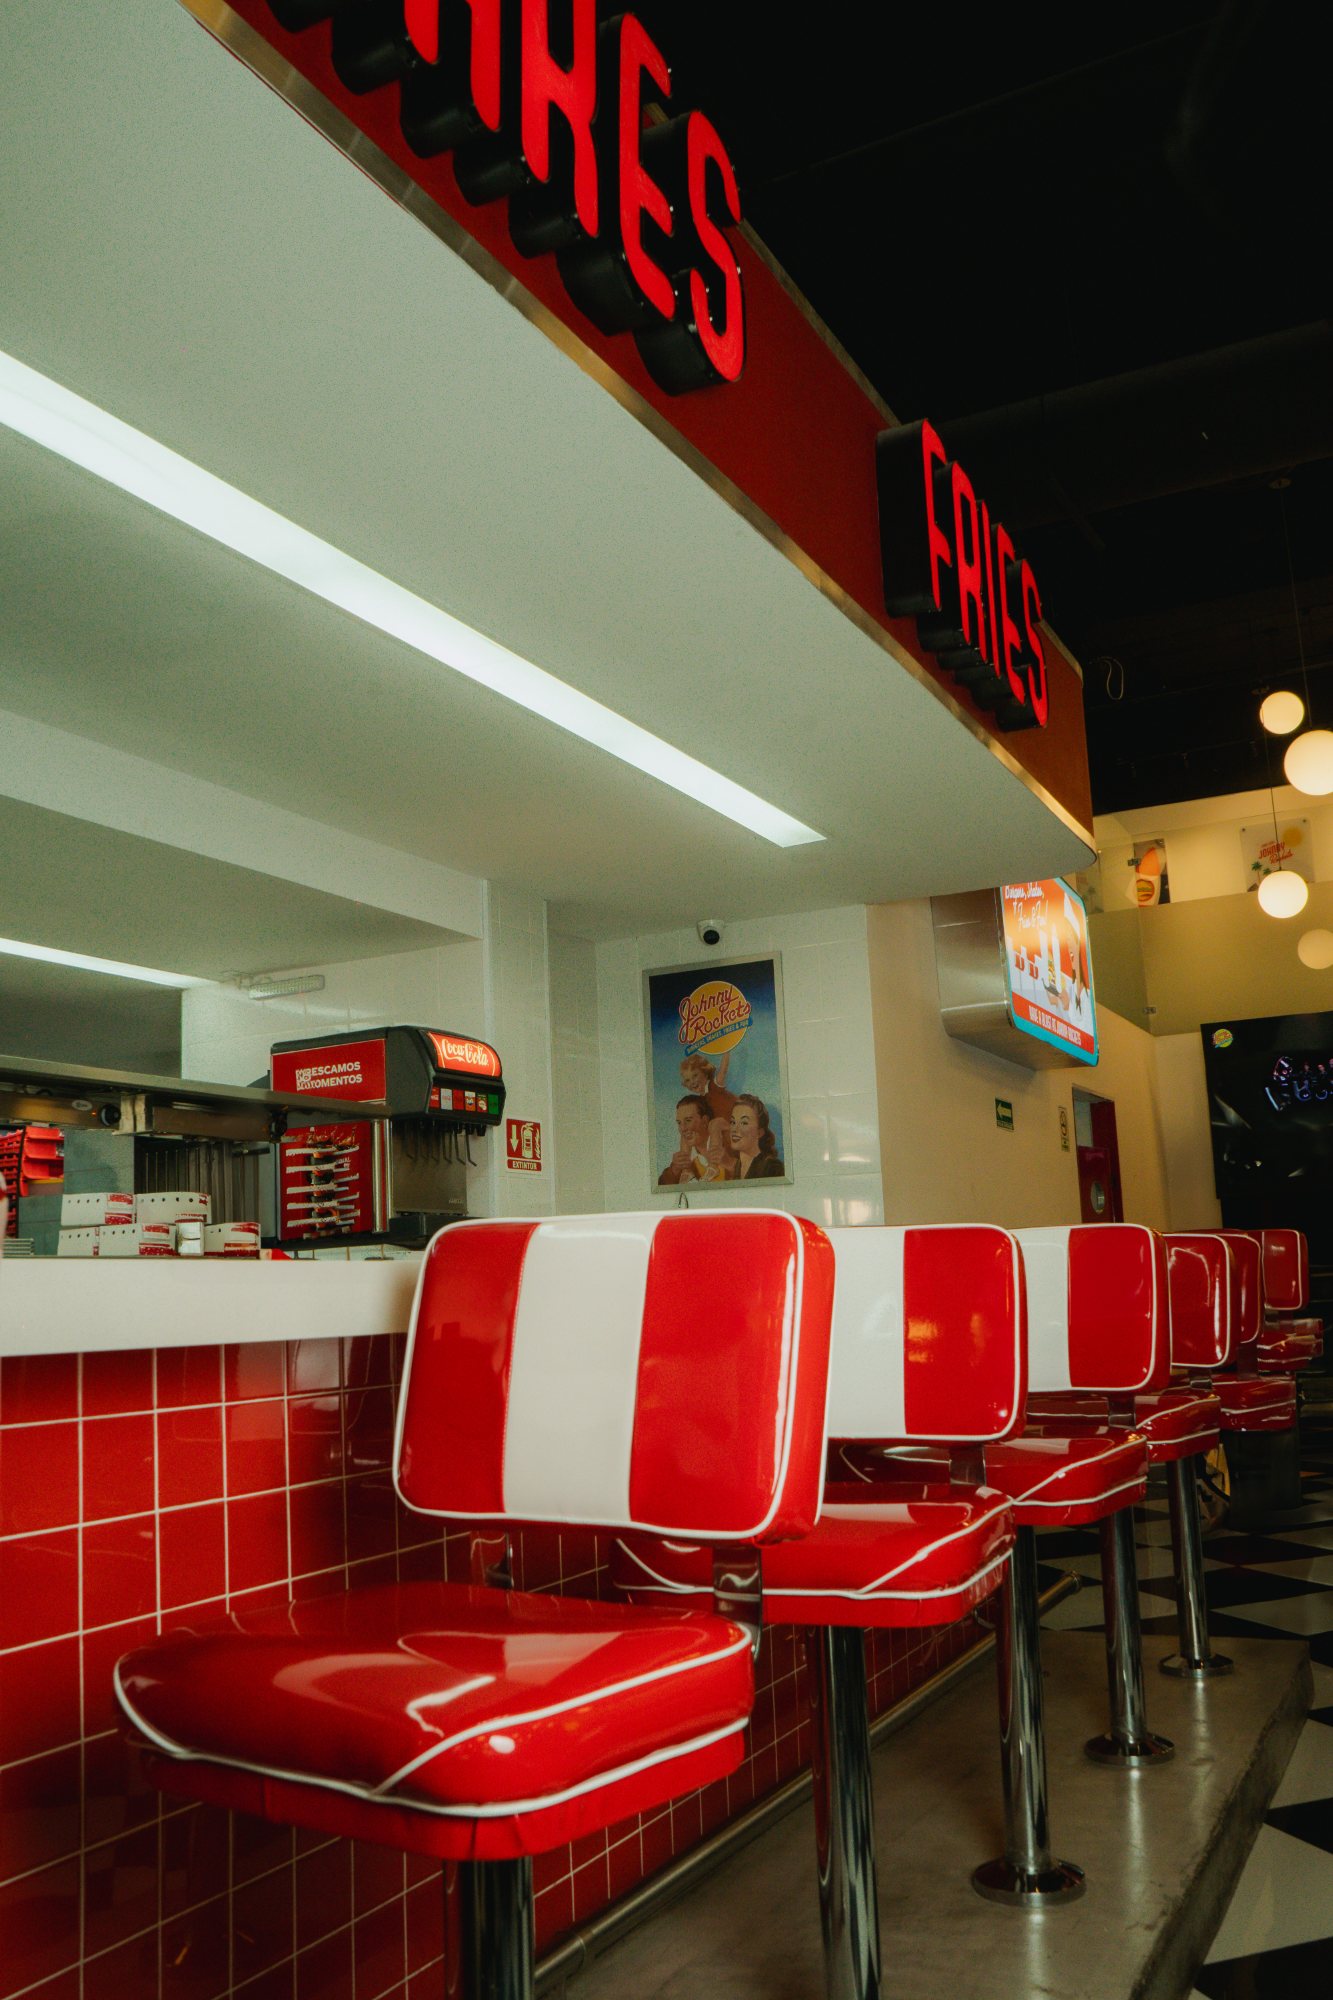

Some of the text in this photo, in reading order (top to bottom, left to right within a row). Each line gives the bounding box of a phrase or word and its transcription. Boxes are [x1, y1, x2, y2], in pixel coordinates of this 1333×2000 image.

[921, 418, 1048, 727] FRIES
[679, 985, 739, 1044] Johnny
[688, 1000, 751, 1043] Rockets
[441, 1038, 489, 1066] Coca-Cola
[512, 1160, 537, 1170] EXTINTOR
